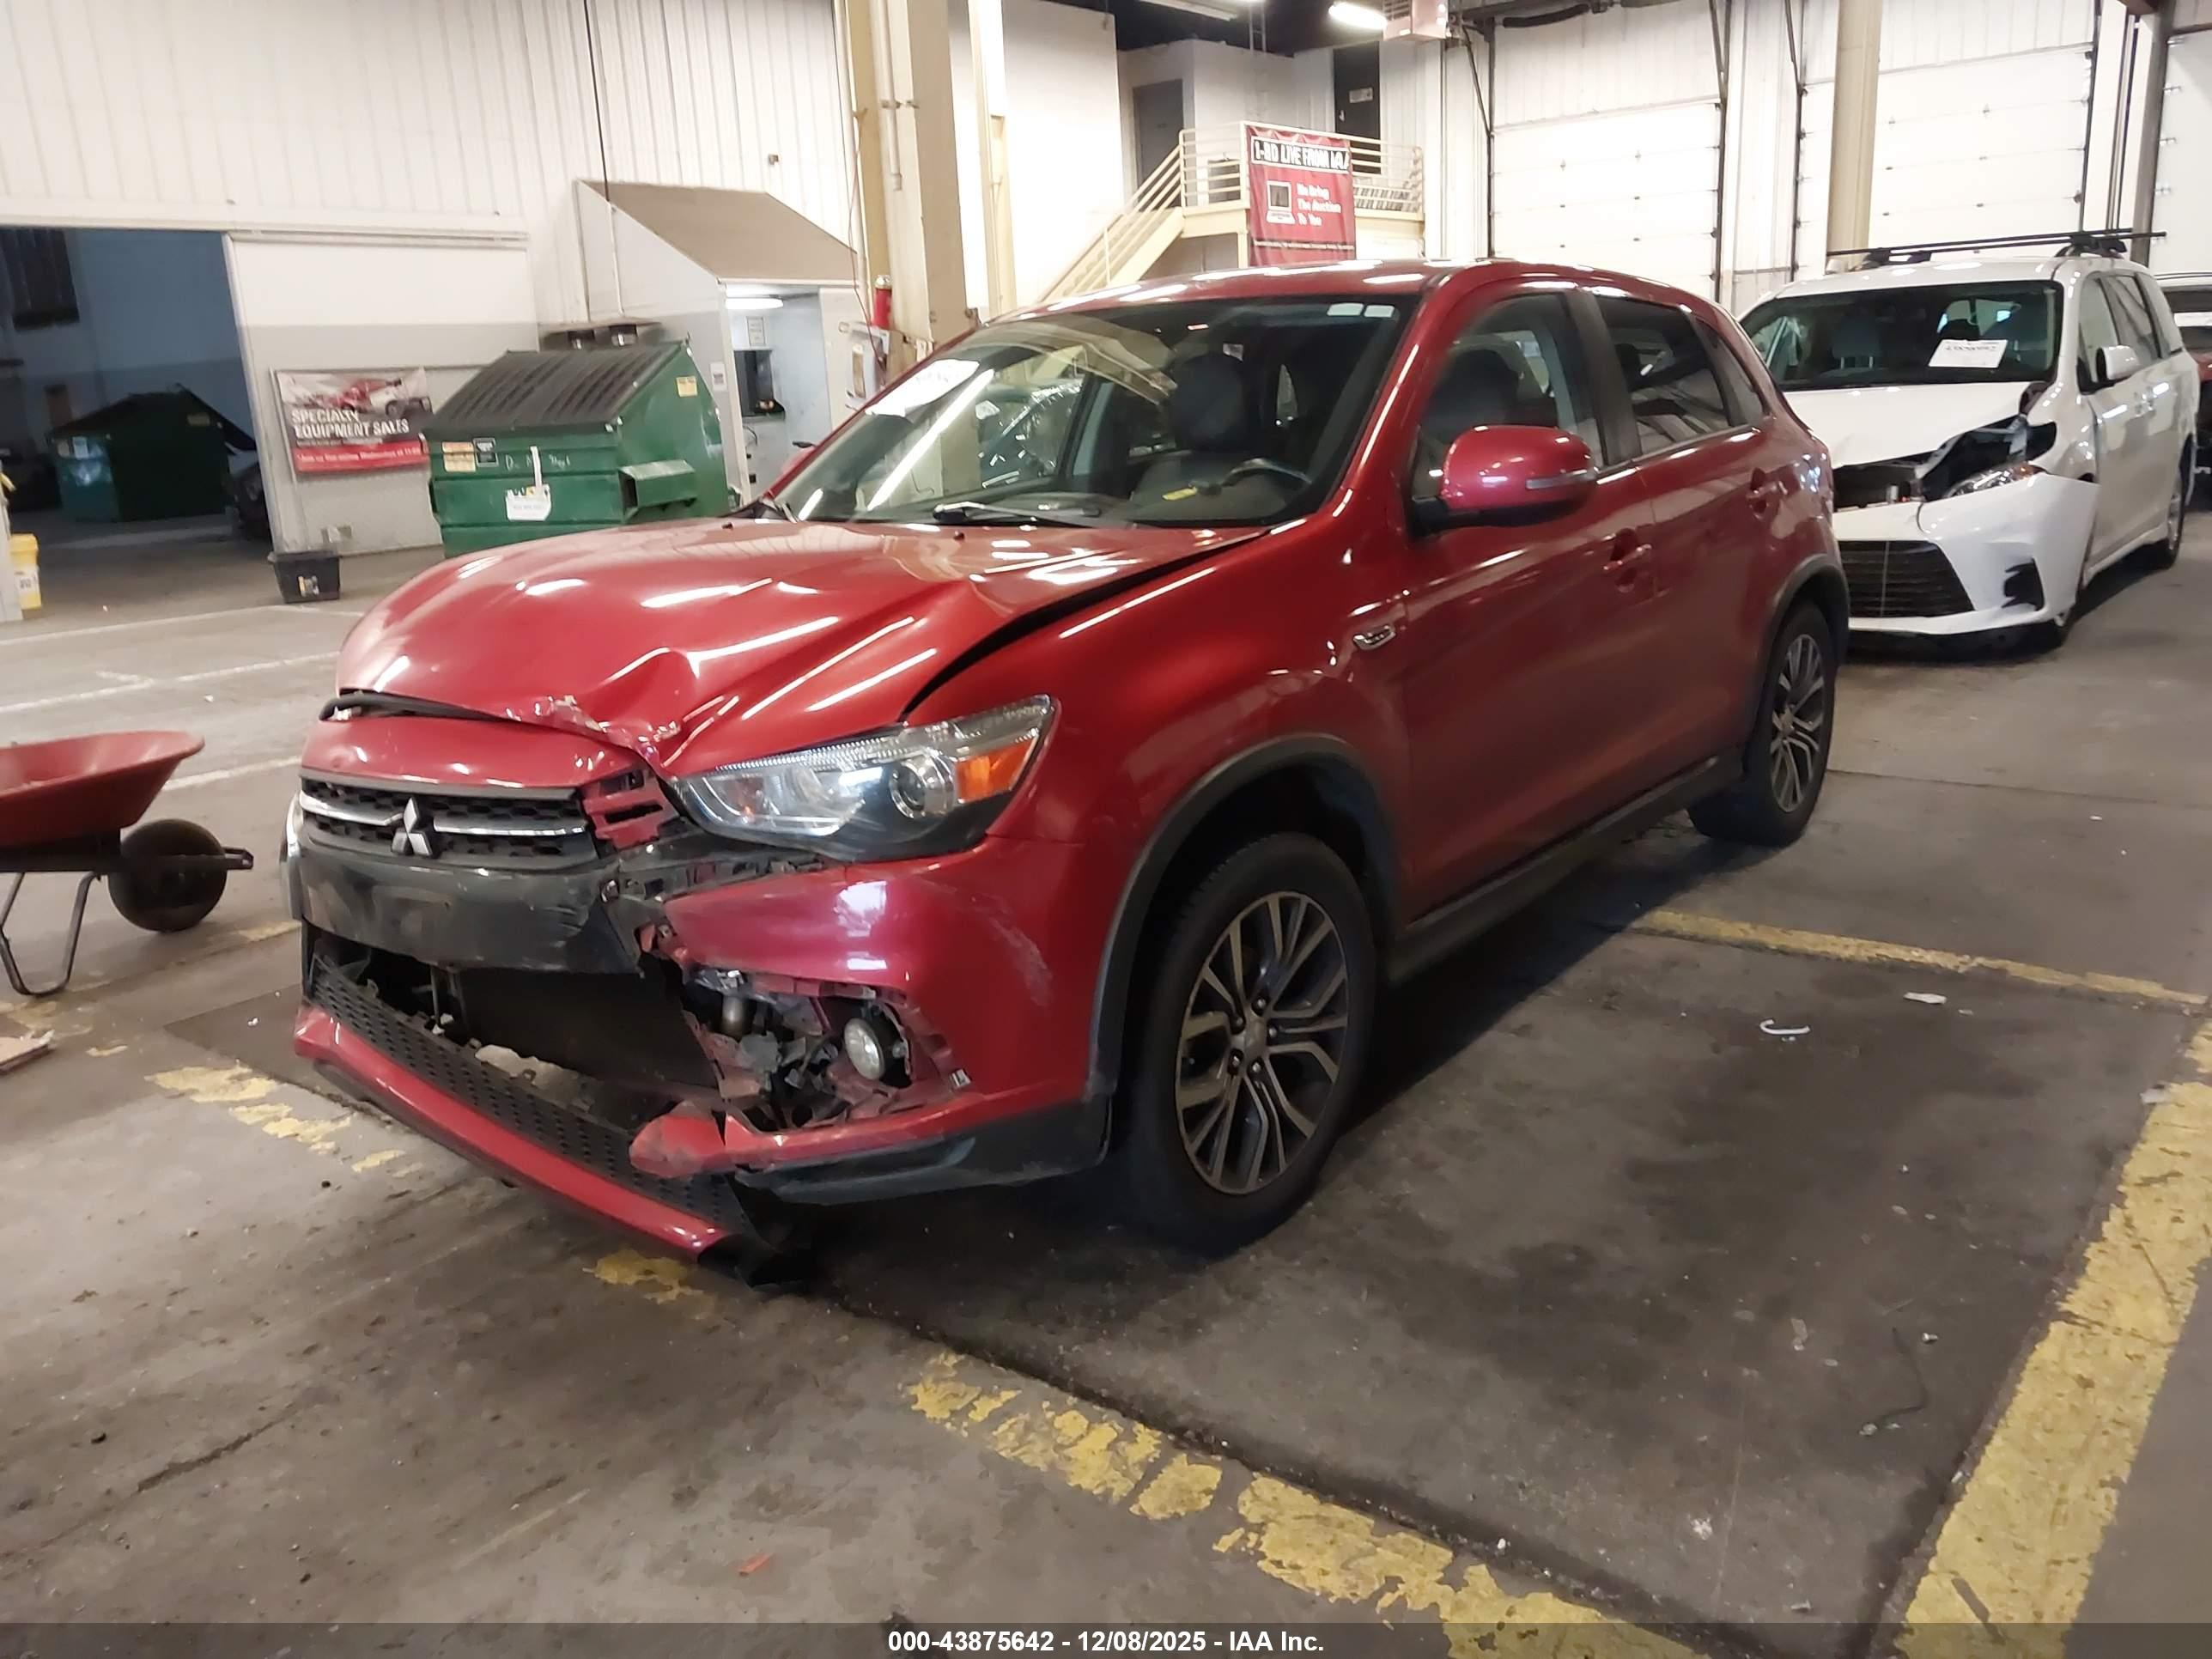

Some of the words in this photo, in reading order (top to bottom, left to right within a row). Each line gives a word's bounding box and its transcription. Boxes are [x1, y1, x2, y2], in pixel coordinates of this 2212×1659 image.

[1280, 143, 1302, 166] LIVE
[1302, 147, 1330, 168] FROM
[291, 408, 360, 424] SPECIALTY
[294, 421, 371, 439] EQUIPMENT
[373, 417, 410, 436] SALES
